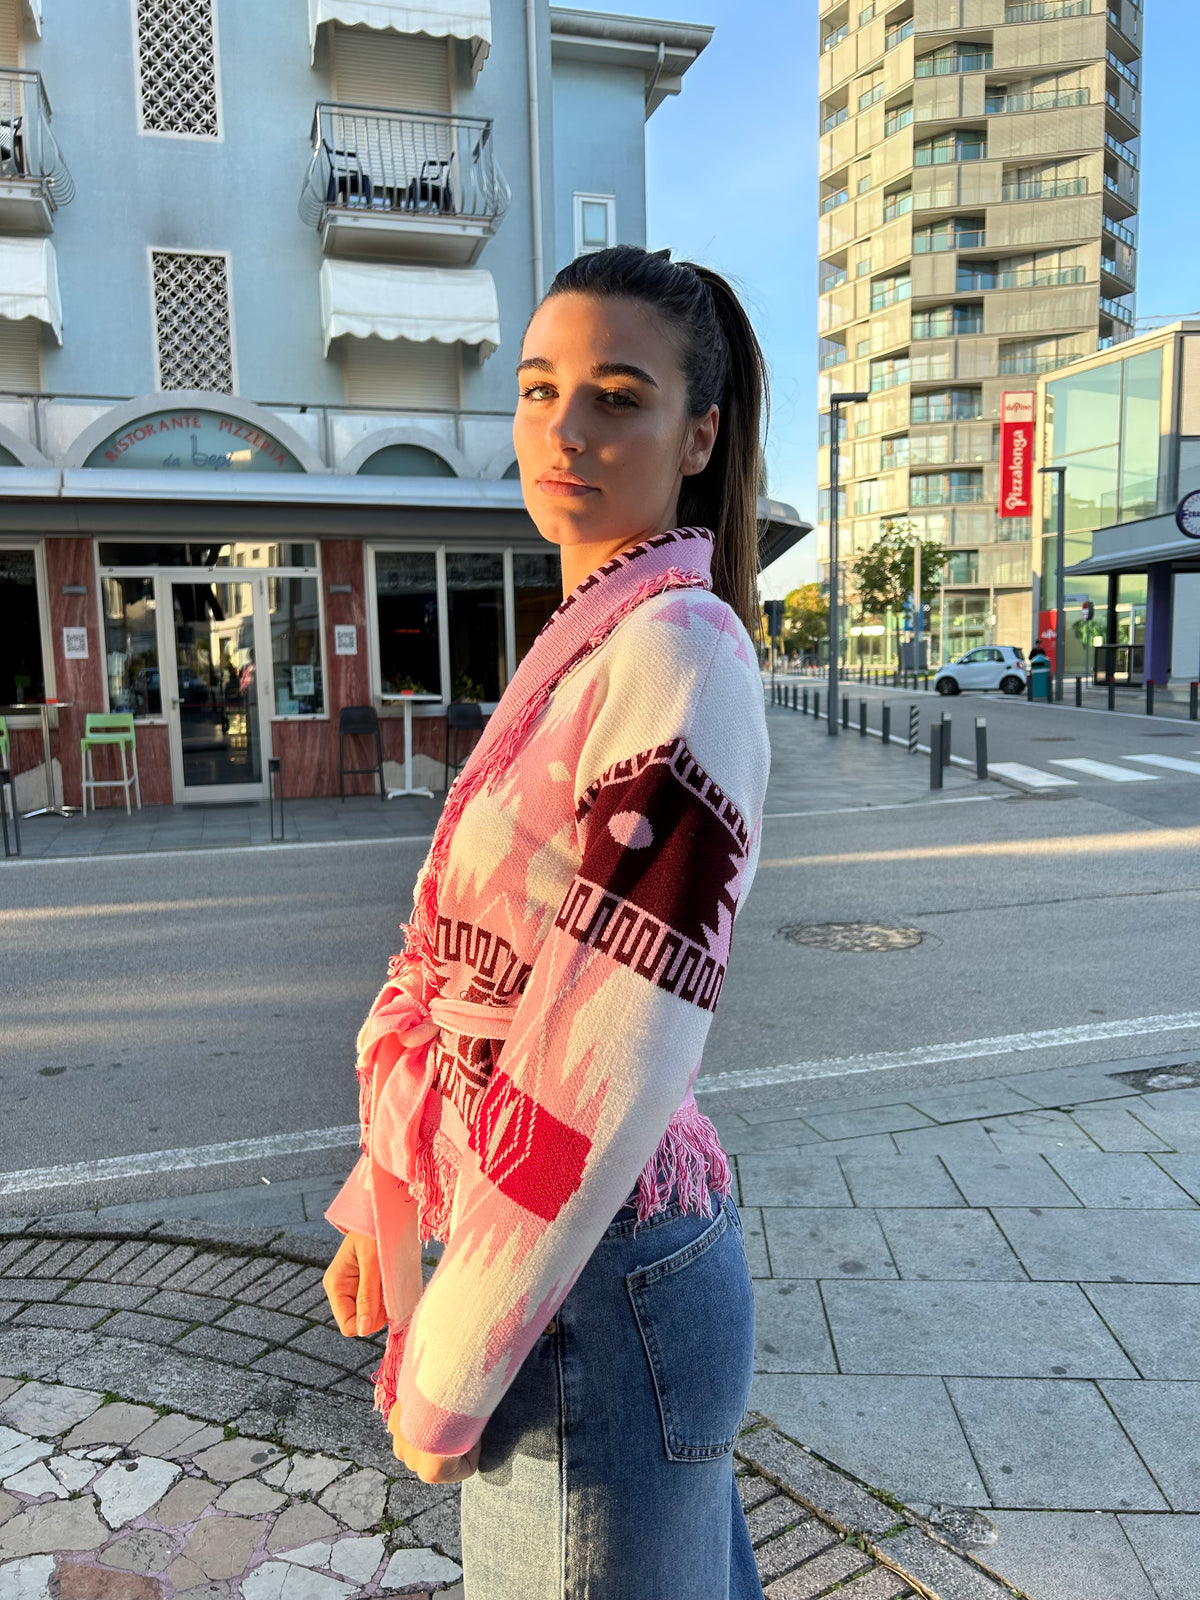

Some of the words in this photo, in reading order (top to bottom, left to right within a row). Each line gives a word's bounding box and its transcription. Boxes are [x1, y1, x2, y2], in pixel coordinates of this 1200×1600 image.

[105, 416, 201, 463] RISTORANTE
[219, 419, 285, 467] PIZZERIA
[162, 456, 182, 468] da
[1005, 430, 1028, 510] Pizzalonga
